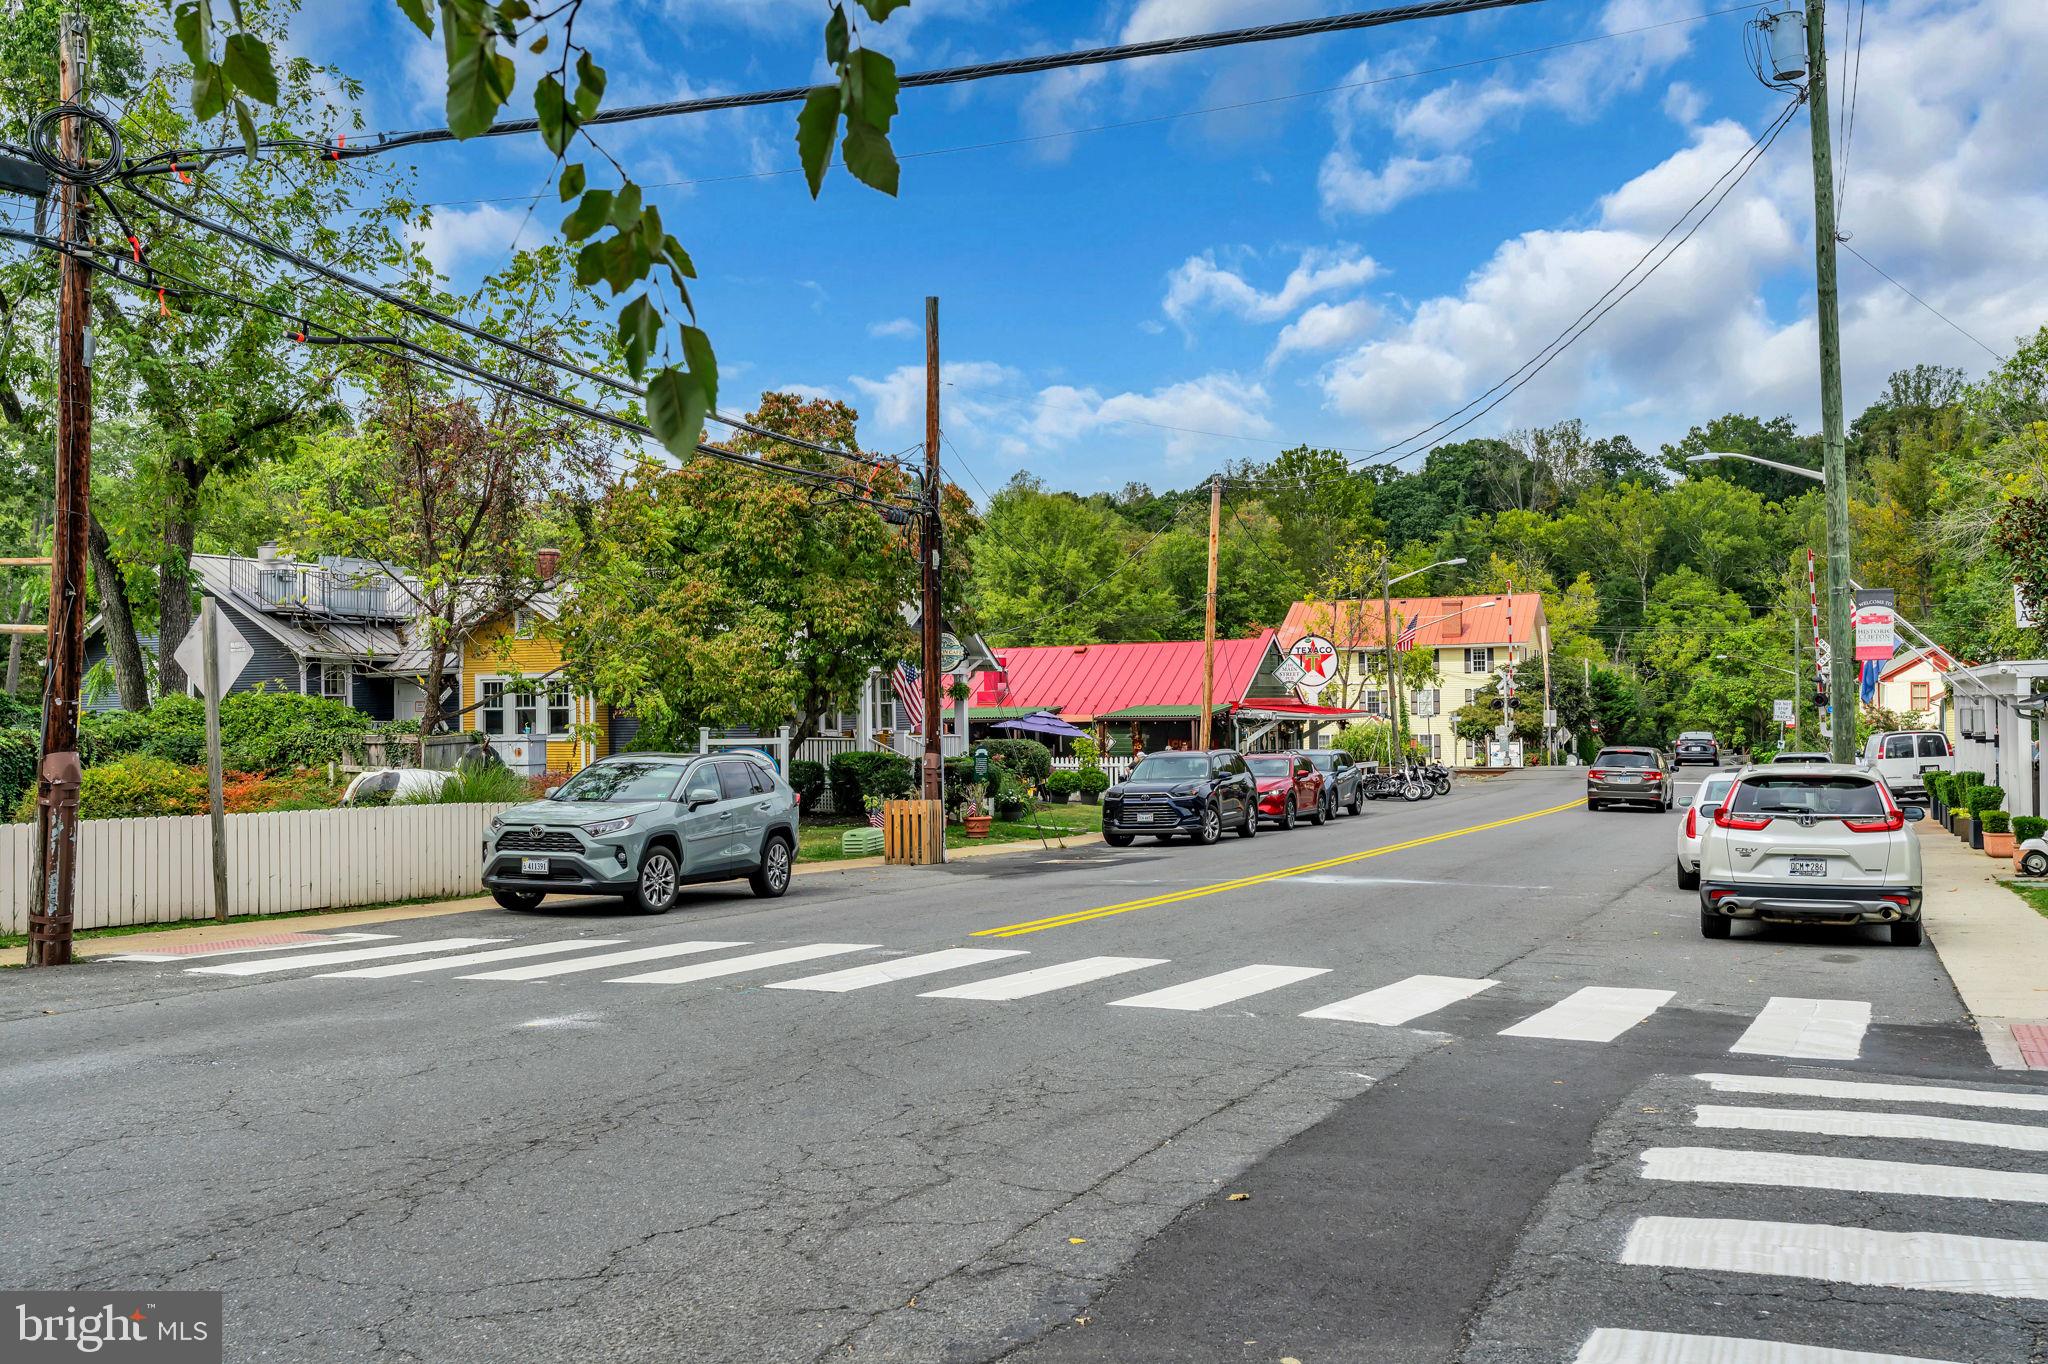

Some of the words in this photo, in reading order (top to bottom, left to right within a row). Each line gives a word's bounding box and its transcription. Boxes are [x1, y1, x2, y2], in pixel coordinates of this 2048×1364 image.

[1858, 599, 1885, 607] WELCOME
[1295, 646, 1333, 654] TEXACO
[1810, 862, 1824, 871] 286
